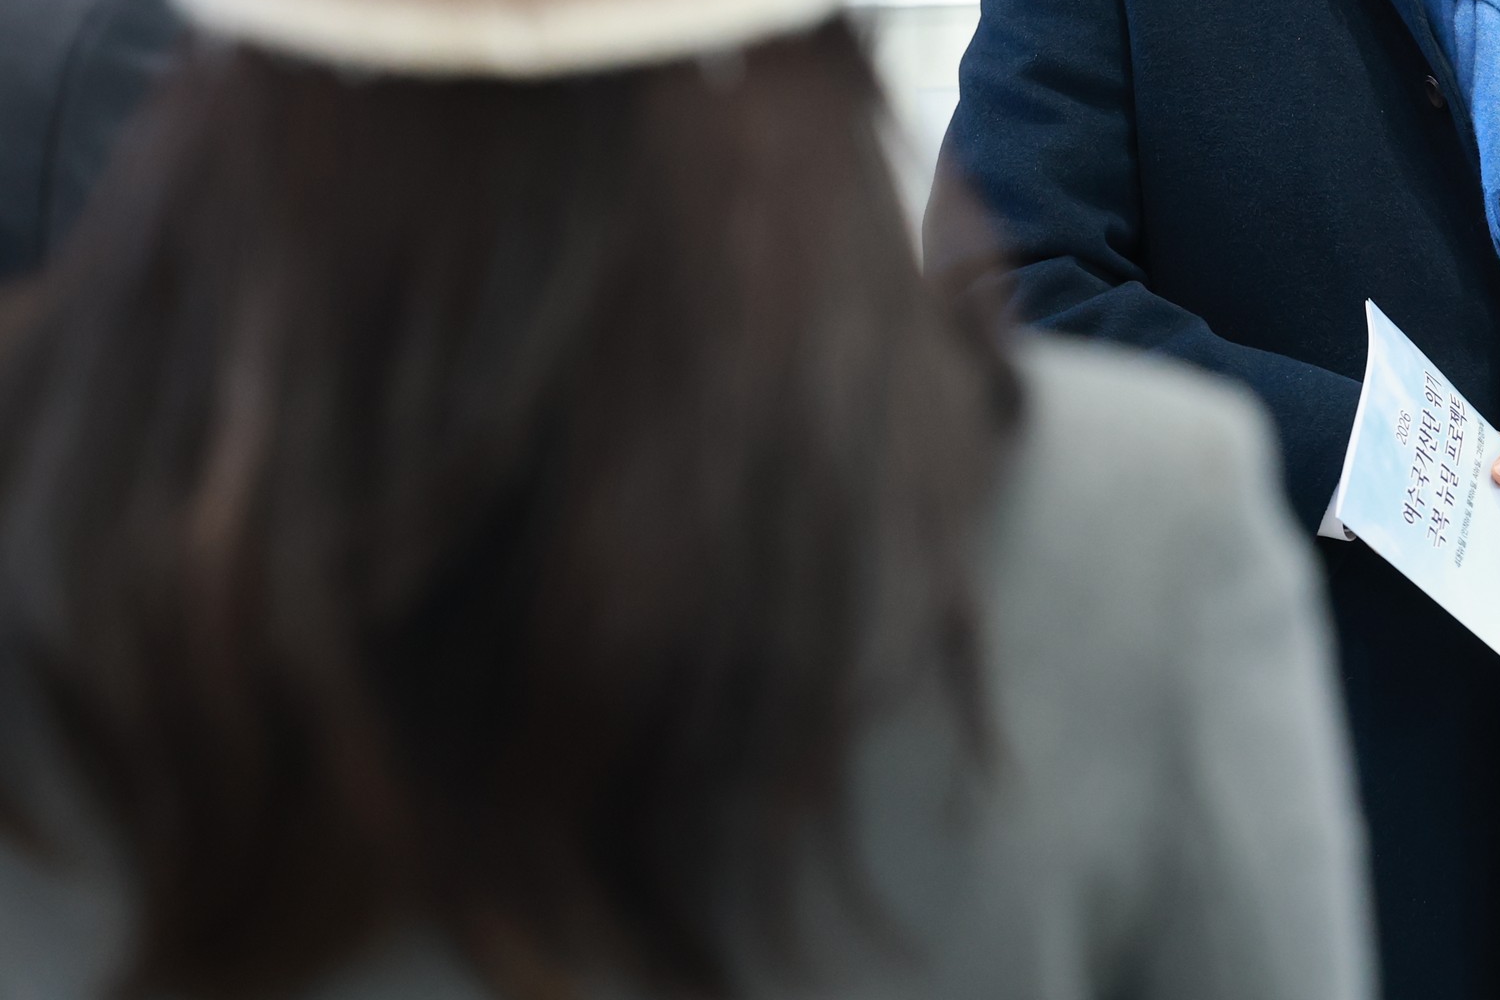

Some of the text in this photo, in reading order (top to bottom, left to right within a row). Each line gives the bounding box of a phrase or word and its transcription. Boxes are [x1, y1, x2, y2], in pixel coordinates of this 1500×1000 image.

[1396, 410, 1411, 445] 2026
[1403, 371, 1443, 524] 여수국가산단 위기
[1427, 394, 1467, 547] 극복 뉴딜 프로젝트
